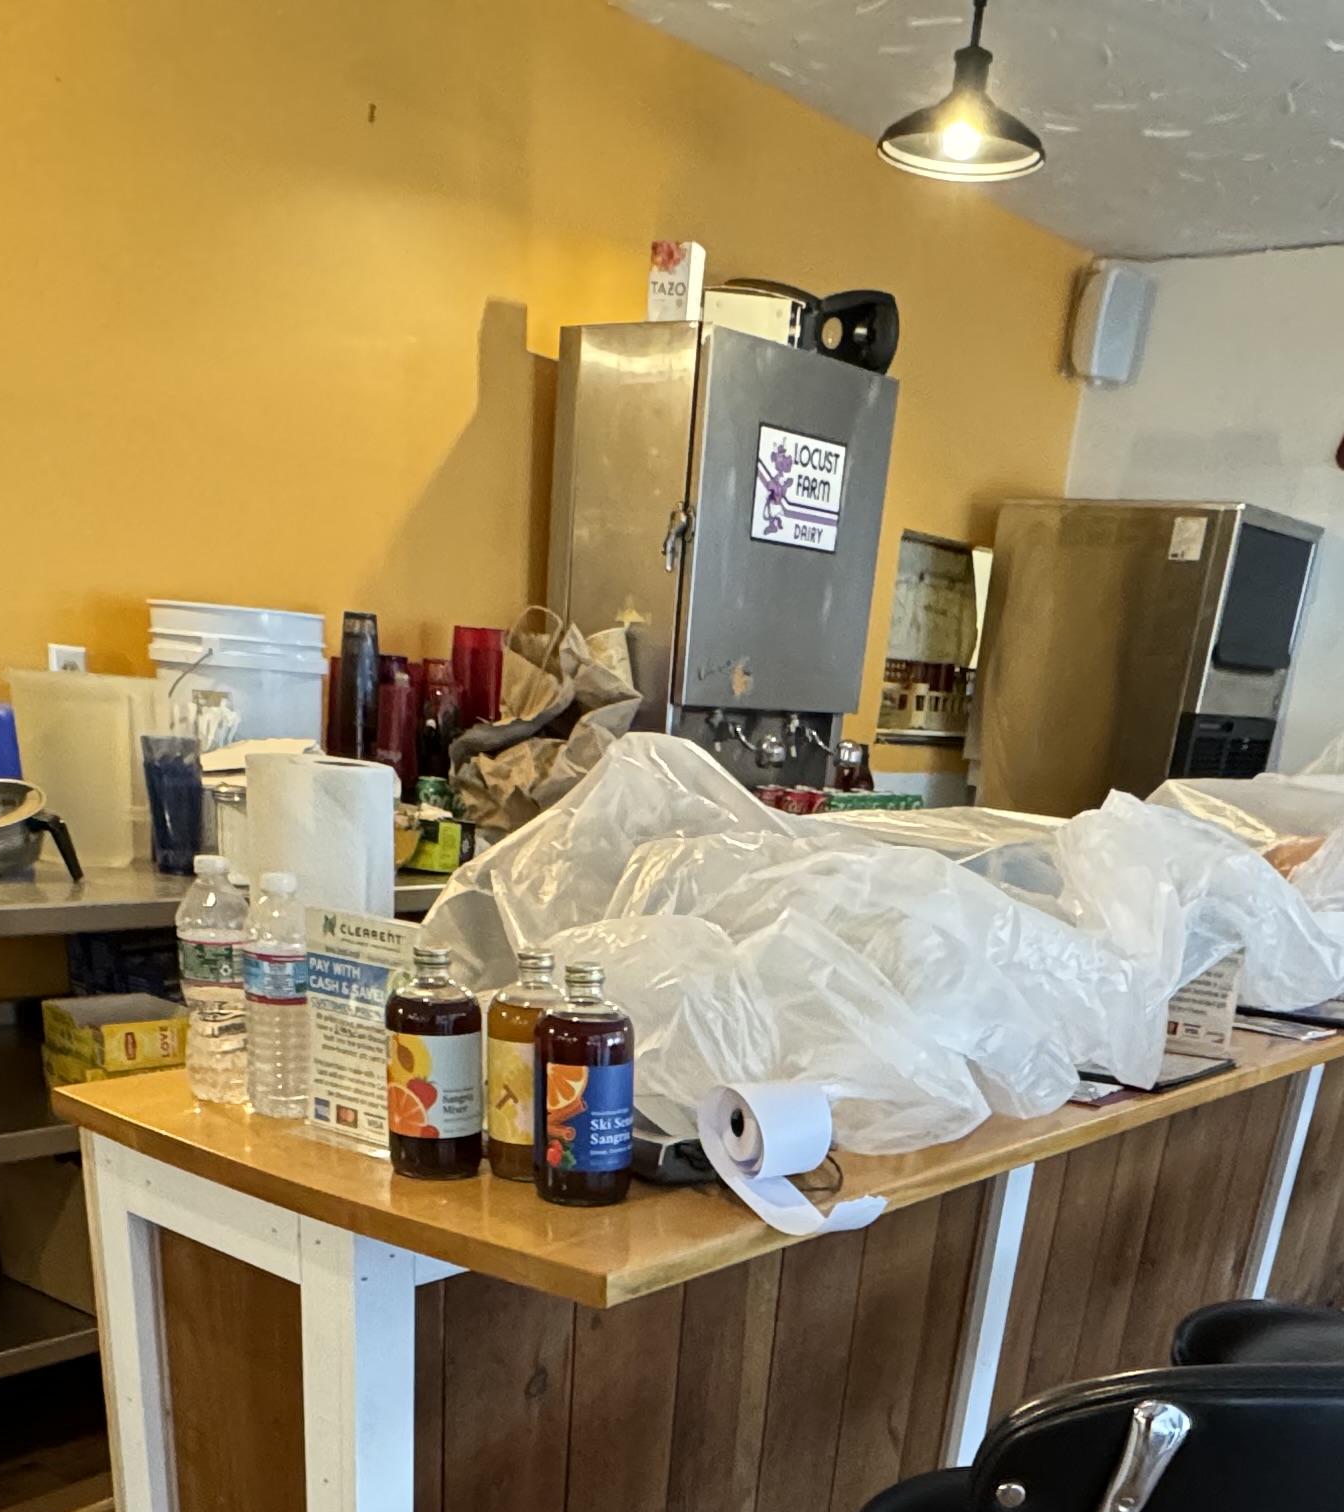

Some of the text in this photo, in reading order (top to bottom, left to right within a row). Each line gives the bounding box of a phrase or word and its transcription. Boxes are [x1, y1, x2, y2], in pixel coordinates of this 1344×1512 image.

[650, 281, 687, 296] TAZO
[793, 442, 840, 475] LOCUST
[796, 474, 831, 503] FARM
[793, 523, 824, 544] DAIRY
[309, 957, 361, 980] PAY WITH
[309, 975, 339, 993] CASH
[341, 981, 349, 995] &
[158, 1025, 170, 1058] LOVE
[590, 1117, 611, 1131] Ski
